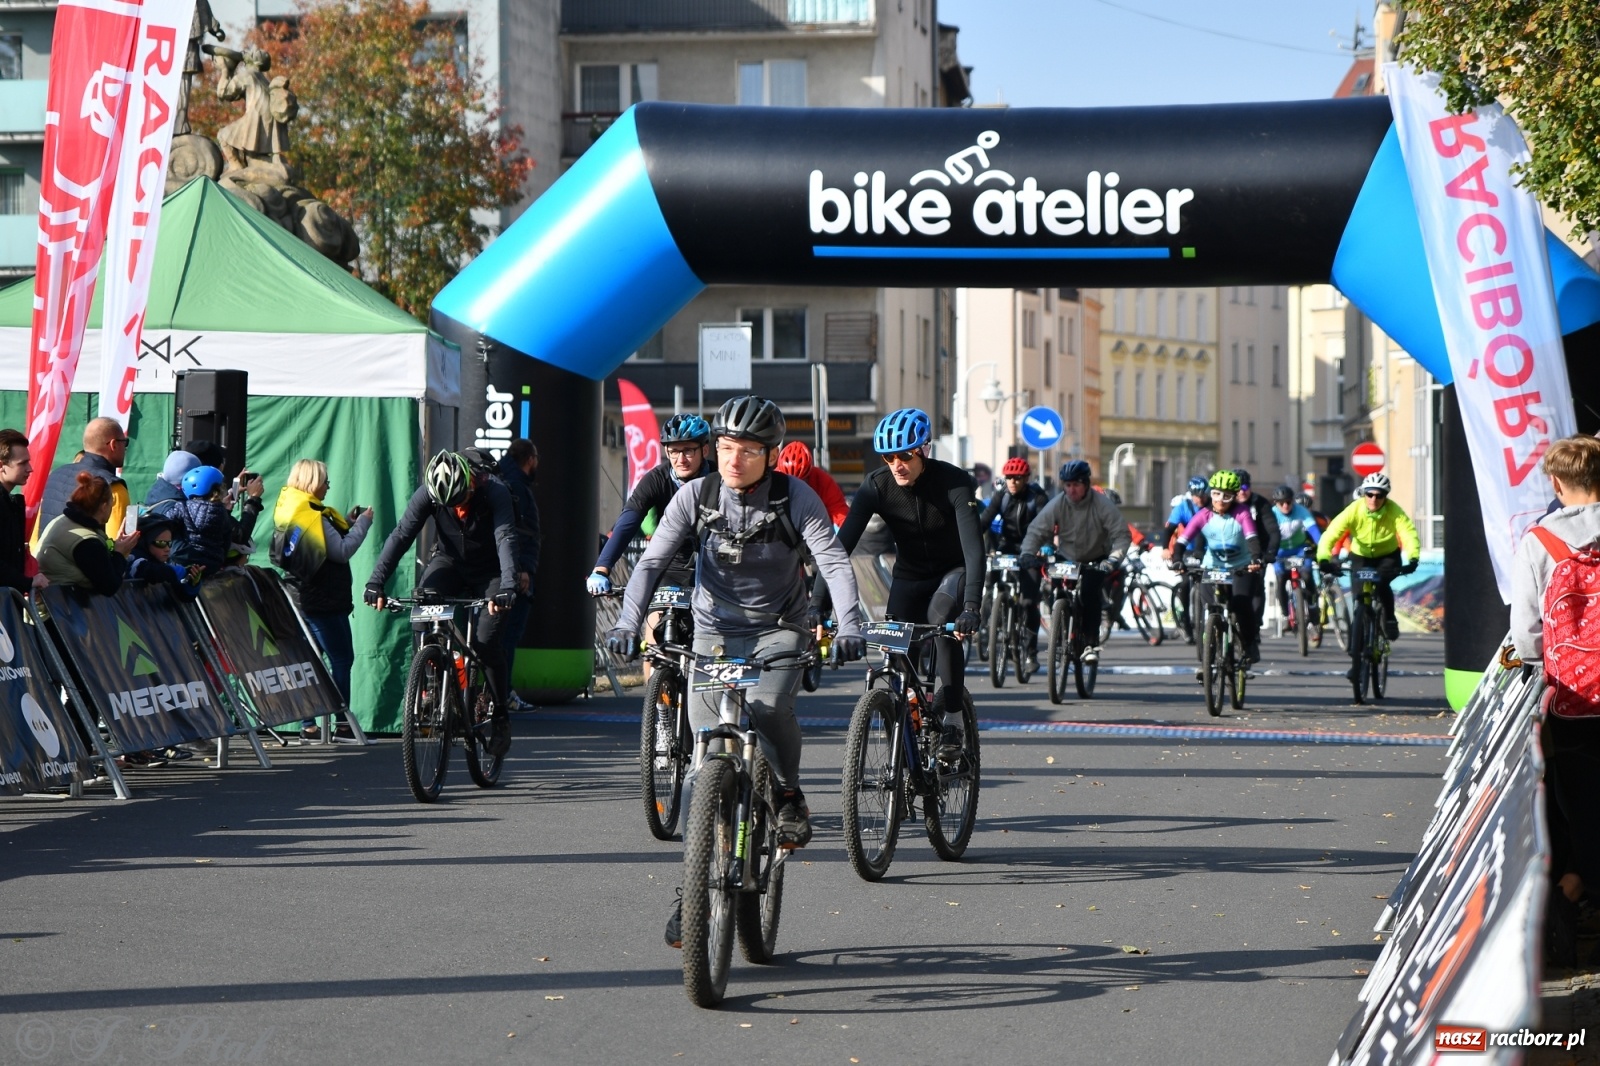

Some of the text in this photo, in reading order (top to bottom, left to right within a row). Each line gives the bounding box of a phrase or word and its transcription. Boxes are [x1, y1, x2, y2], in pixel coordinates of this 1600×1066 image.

[809, 170, 1194, 235] bike atelier
[474, 383, 514, 461] lier
[420, 606, 444, 616] 200
[654, 596, 679, 604] 151
[866, 629, 904, 638] OPIEKUN
[245, 661, 320, 698] MERIDA
[108, 680, 210, 720] MERDA
